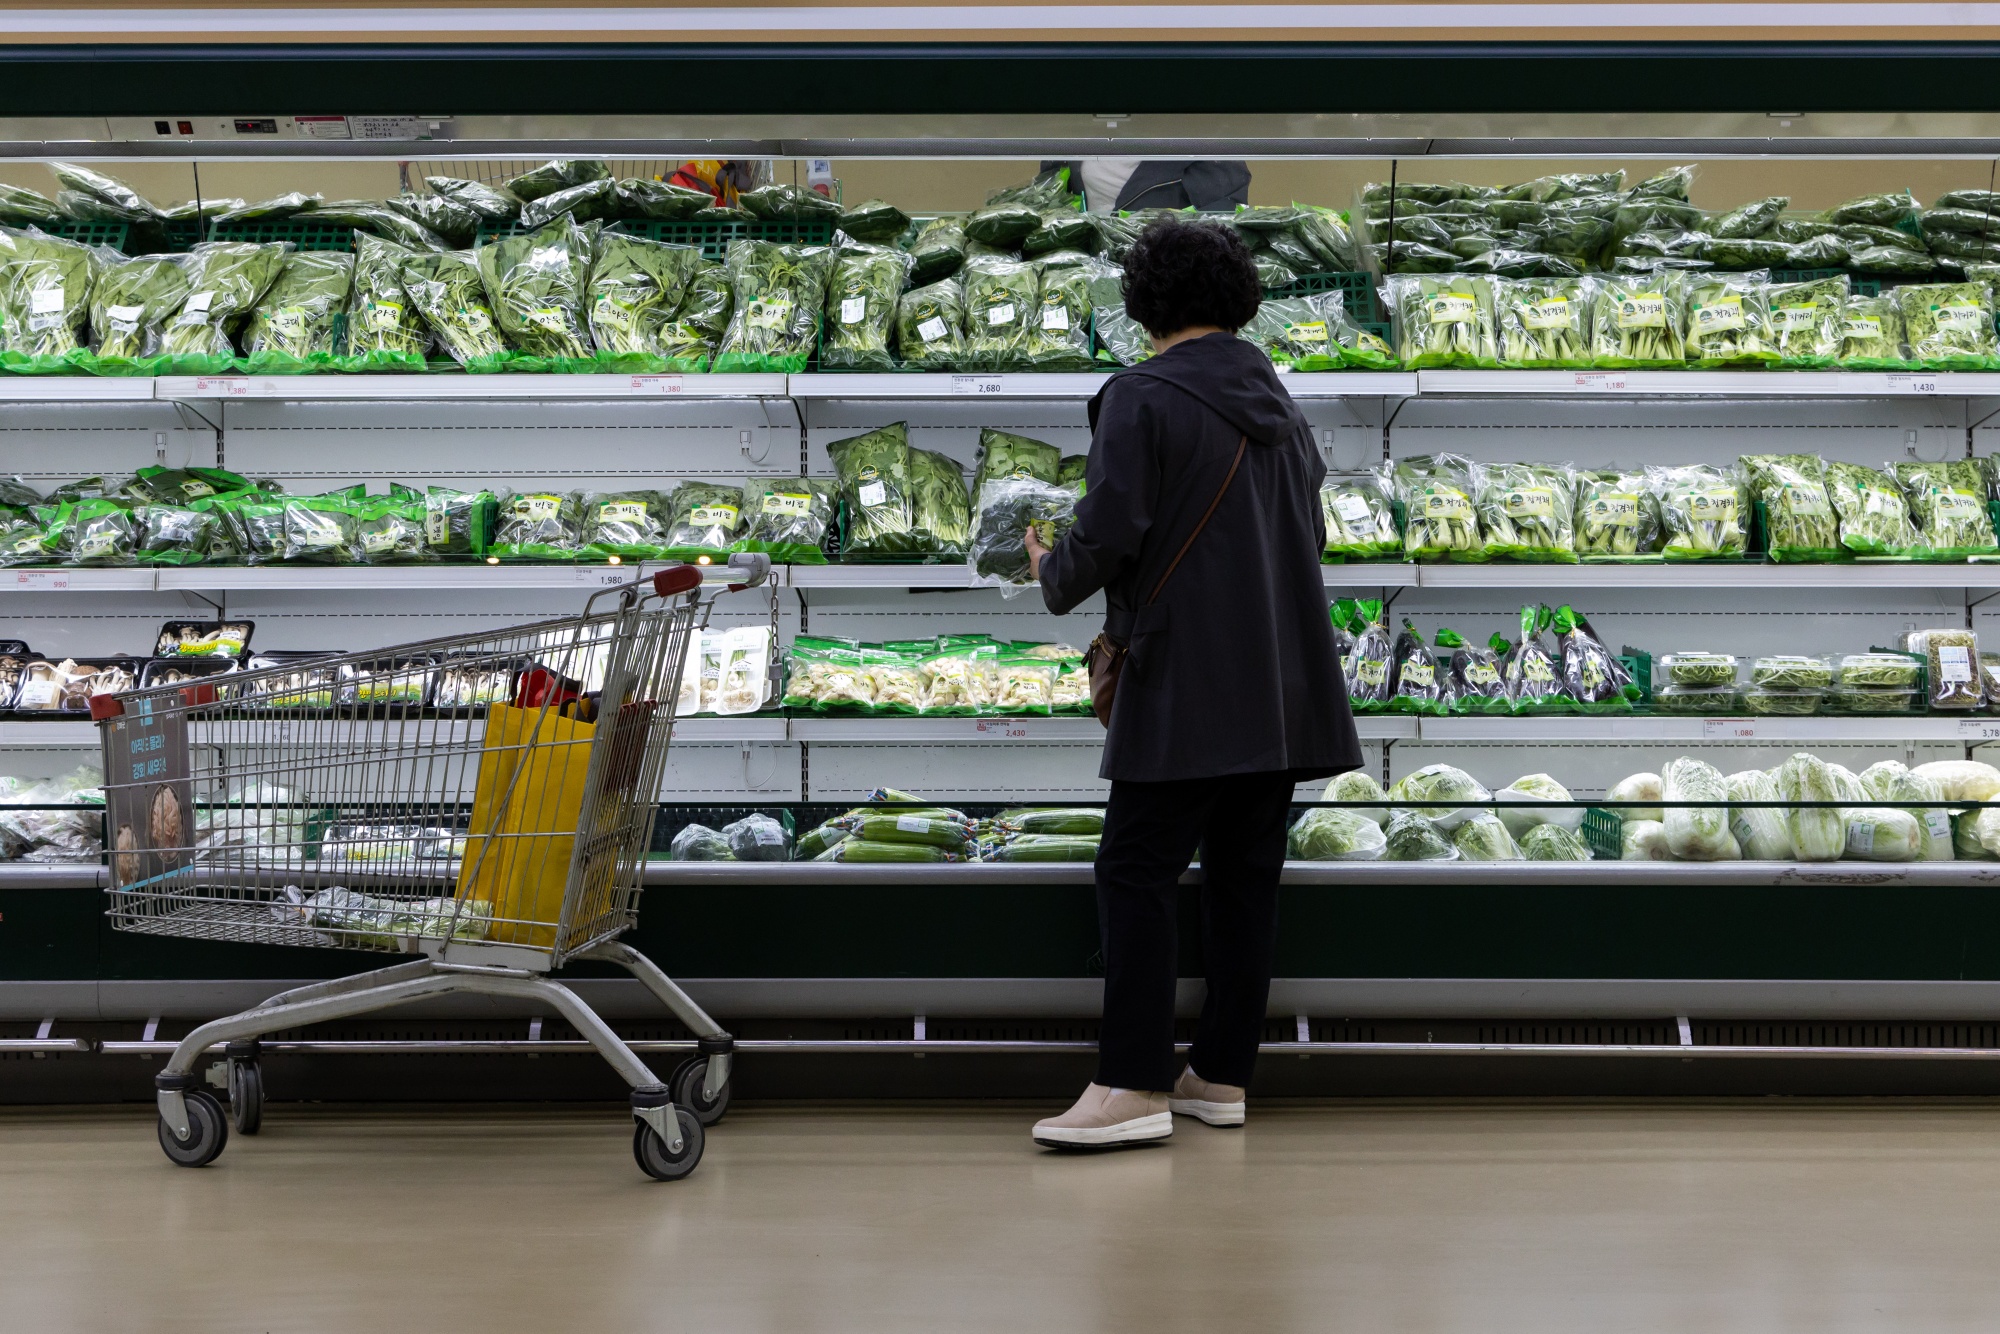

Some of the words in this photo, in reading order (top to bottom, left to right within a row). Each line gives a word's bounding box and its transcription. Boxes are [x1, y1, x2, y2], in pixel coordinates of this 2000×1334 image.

[1542, 305, 1566, 317] 청경채
[1637, 303, 1662, 314] 청경채
[612, 310, 629, 322] 아욱
[281, 315, 300, 328] 근대
[979, 384, 1001, 393] 2,680
[1913, 384, 1935, 392] 1,430
[1711, 498, 1735, 508] 청경채
[1610, 503, 1635, 514] 청경채
[601, 576, 623, 585] 1,980
[1006, 729, 1026, 737] 2,430
[1734, 729, 1754, 737] 1,080
